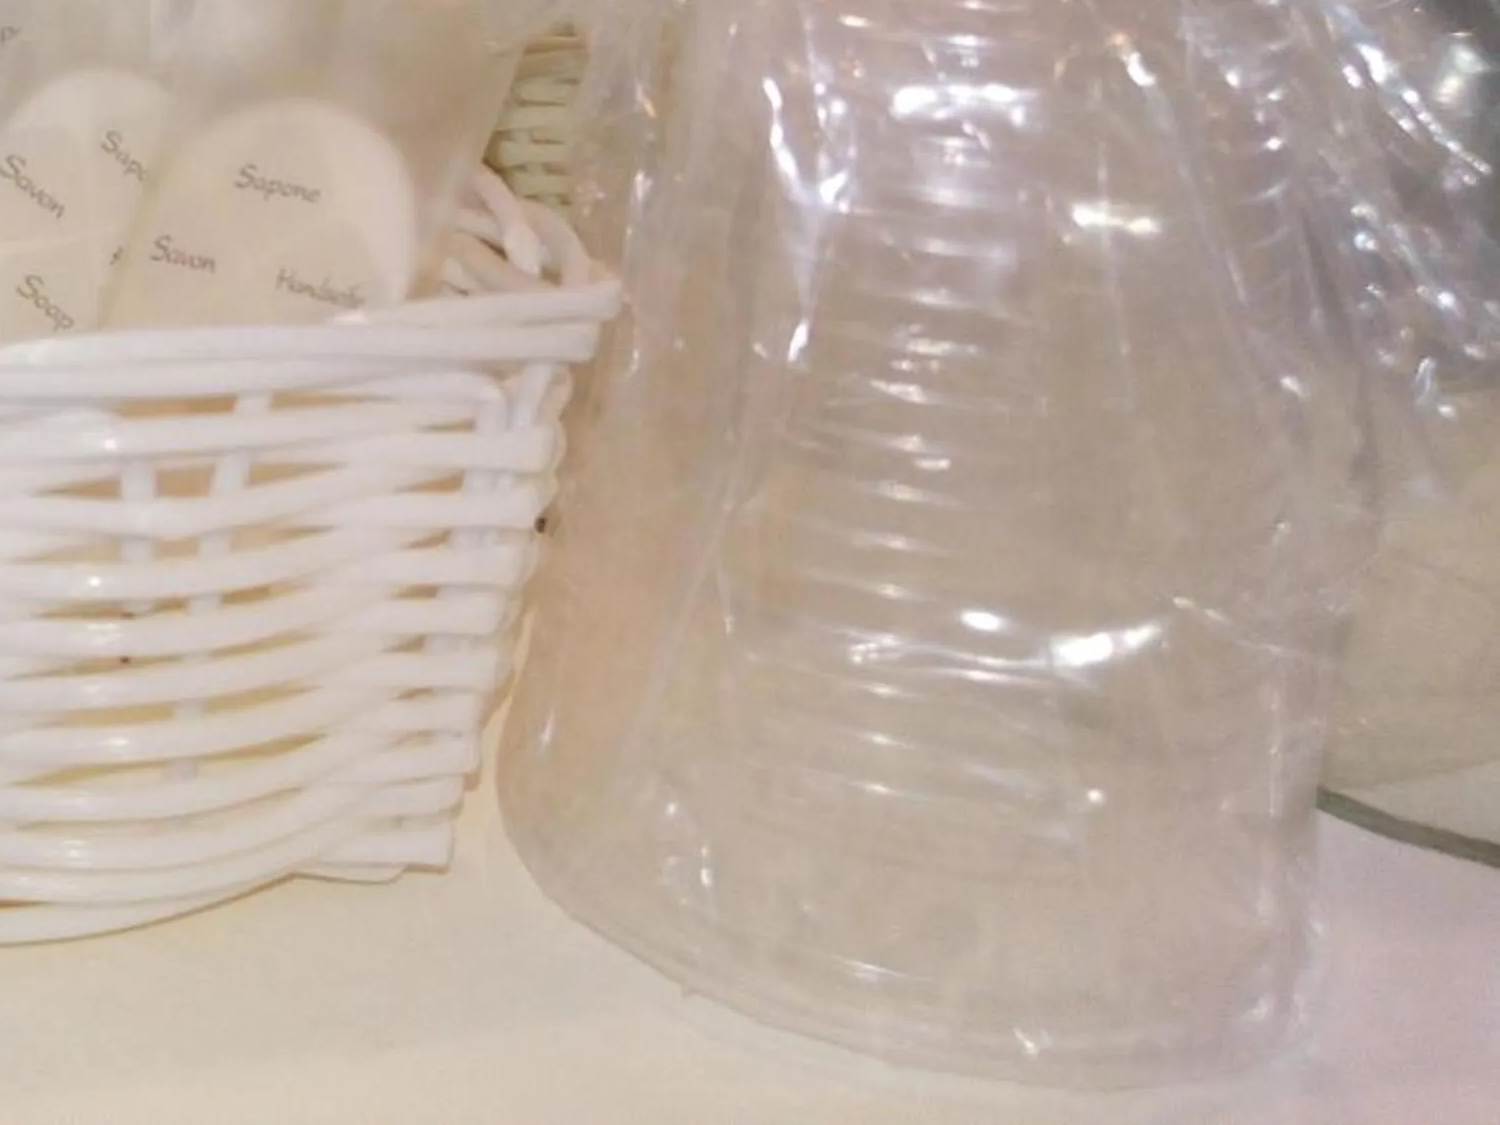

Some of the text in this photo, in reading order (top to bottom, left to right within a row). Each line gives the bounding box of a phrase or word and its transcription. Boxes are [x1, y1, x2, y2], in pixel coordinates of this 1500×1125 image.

[99, 129, 149, 184] Sap
[232, 161, 323, 205] Sapone
[149, 234, 217, 274] Savon
[15, 274, 76, 333] Soap
